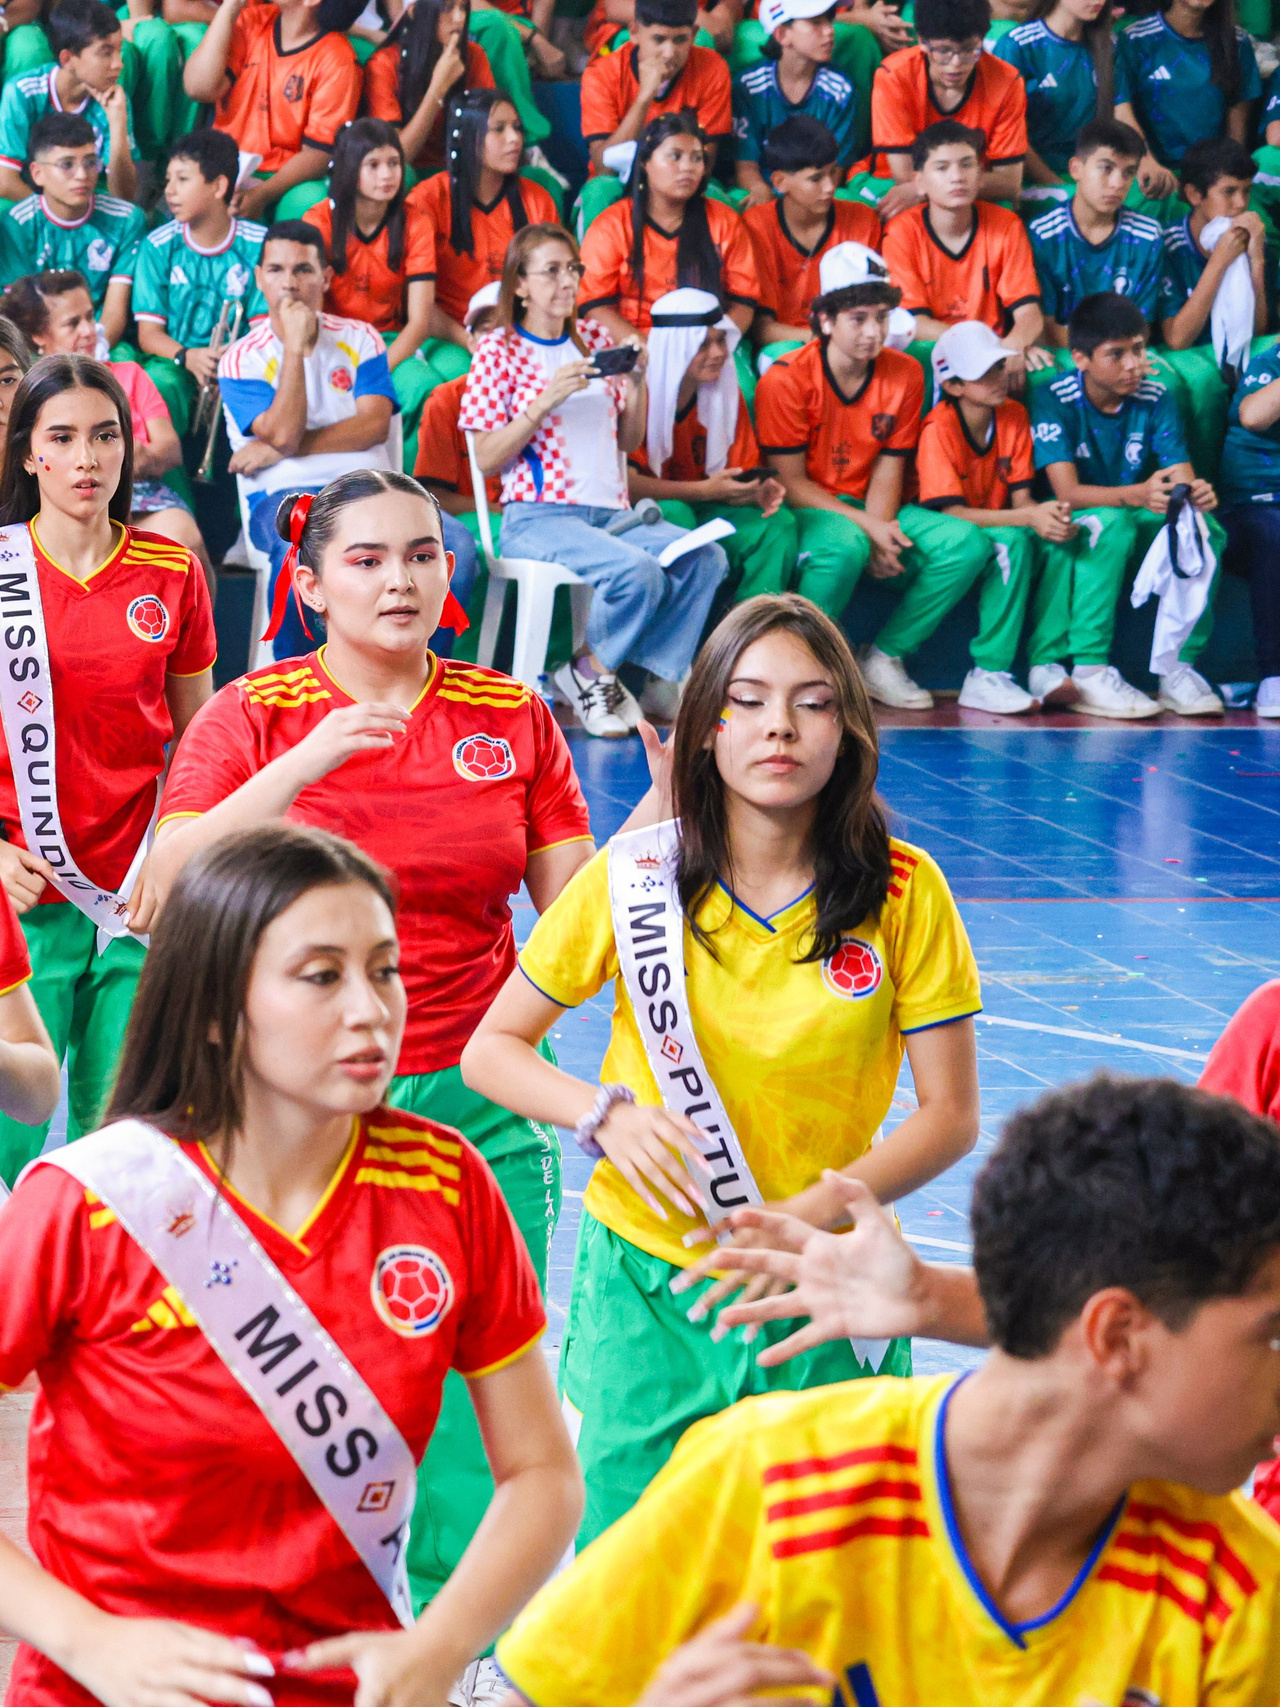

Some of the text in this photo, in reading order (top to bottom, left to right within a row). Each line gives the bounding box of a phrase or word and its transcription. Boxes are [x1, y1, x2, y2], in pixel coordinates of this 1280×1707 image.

[20, 722, 98, 890] QUINDIO
[627, 902, 678, 1034] MISS
[540, 1156, 554, 1185] DE
[544, 1189, 555, 1217] LA
[234, 1304, 379, 1478] MISS
